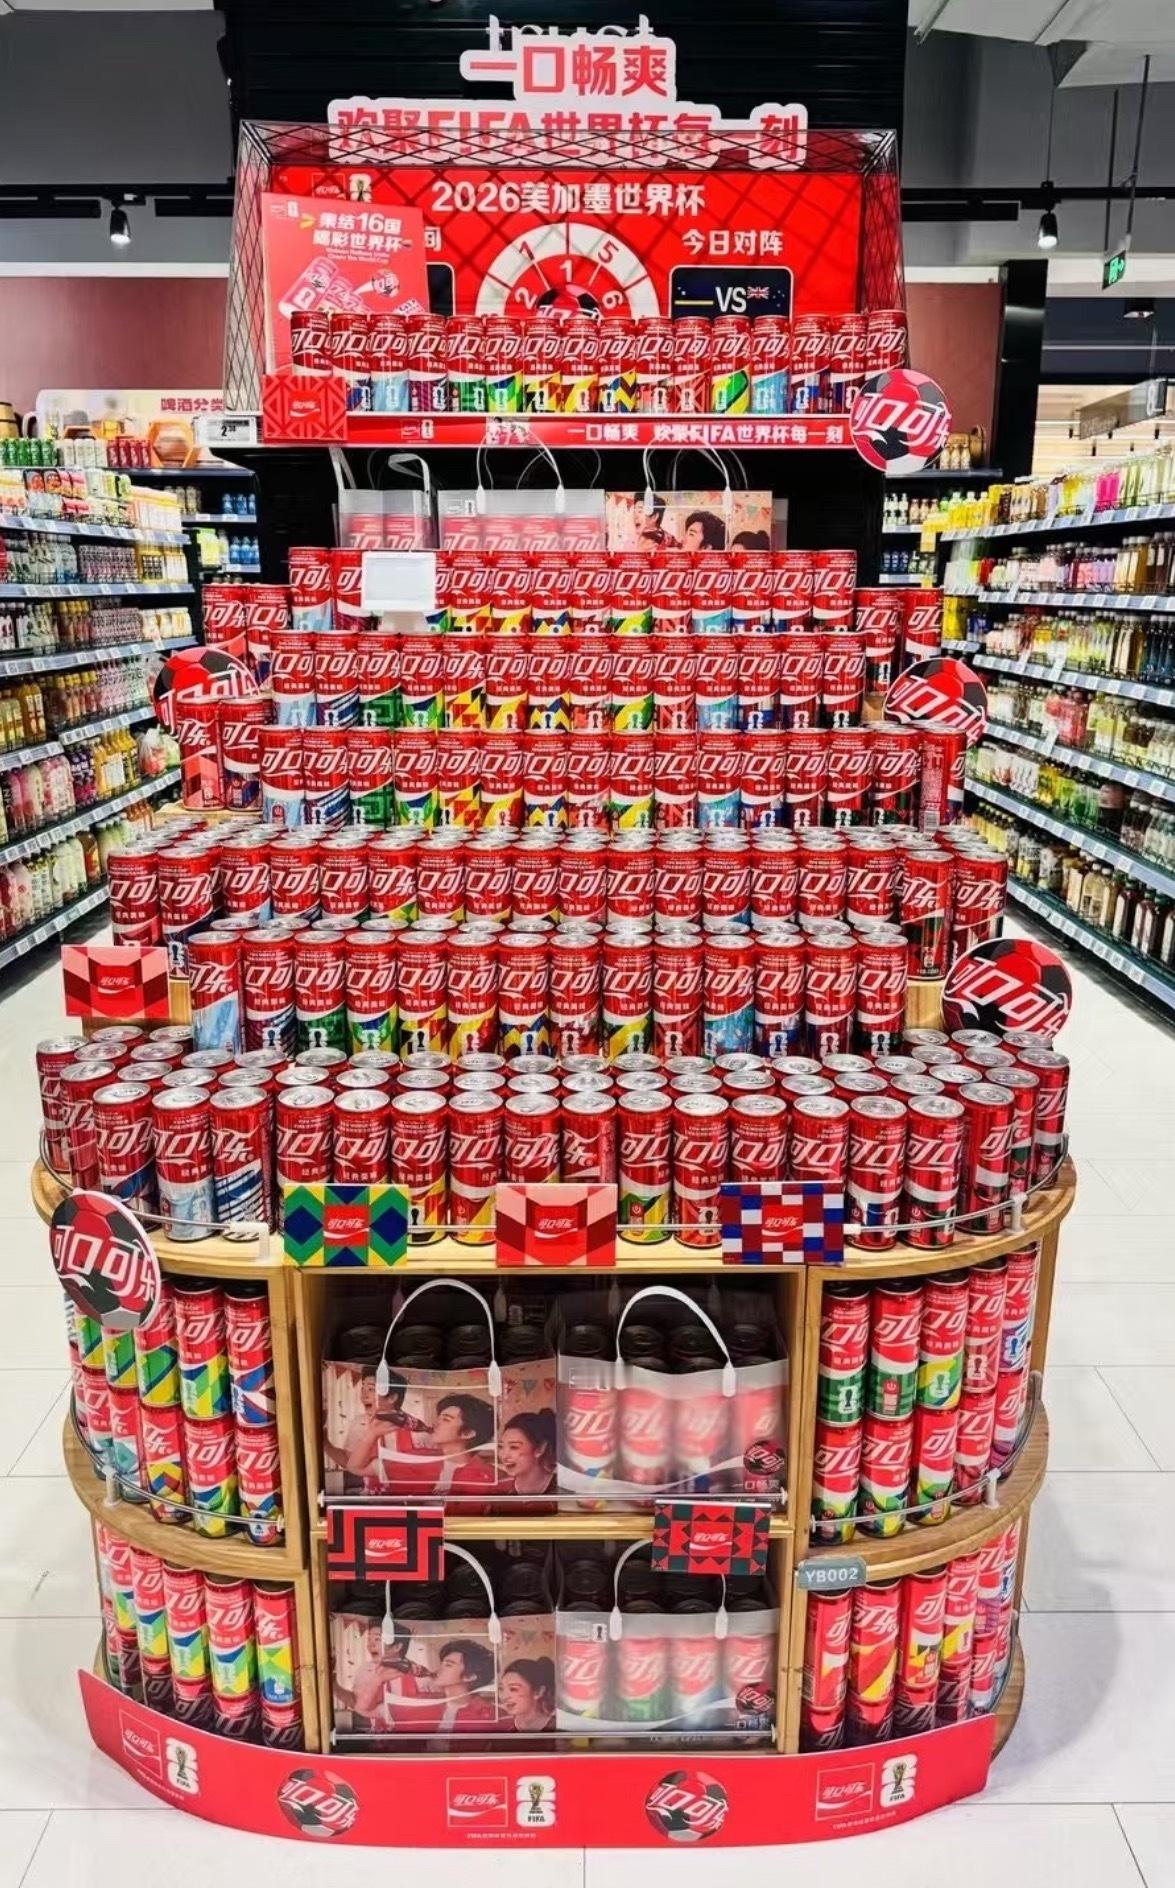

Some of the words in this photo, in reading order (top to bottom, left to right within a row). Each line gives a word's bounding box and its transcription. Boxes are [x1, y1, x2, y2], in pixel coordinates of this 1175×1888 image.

[470, 45, 668, 97] 一口畅爽
[432, 181, 705, 216] 2026美加墨世界杯
[682, 229, 783, 256] 今日对阵
[598, 242, 621, 265] 5
[560, 260, 573, 283] 1
[514, 288, 537, 311] 2
[602, 289, 624, 310] 6
[716, 287, 747, 313] VS
[853, 390, 950, 450] 可口可乐
[568, 426, 639, 443] 一口畅爽
[100, 975, 132, 987] 可口可乐
[327, 1217, 364, 1230] 可口可乐
[538, 1217, 574, 1229] 可口可乐
[764, 1216, 799, 1229] 可口可乐
[368, 1537, 403, 1549] 可口可乐
[805, 1567, 859, 1584] YB002
[822, 1780, 867, 1799] 可口可乐
[453, 1792, 500, 1807] 可口可乐
[527, 1815, 545, 1823] FIFA
